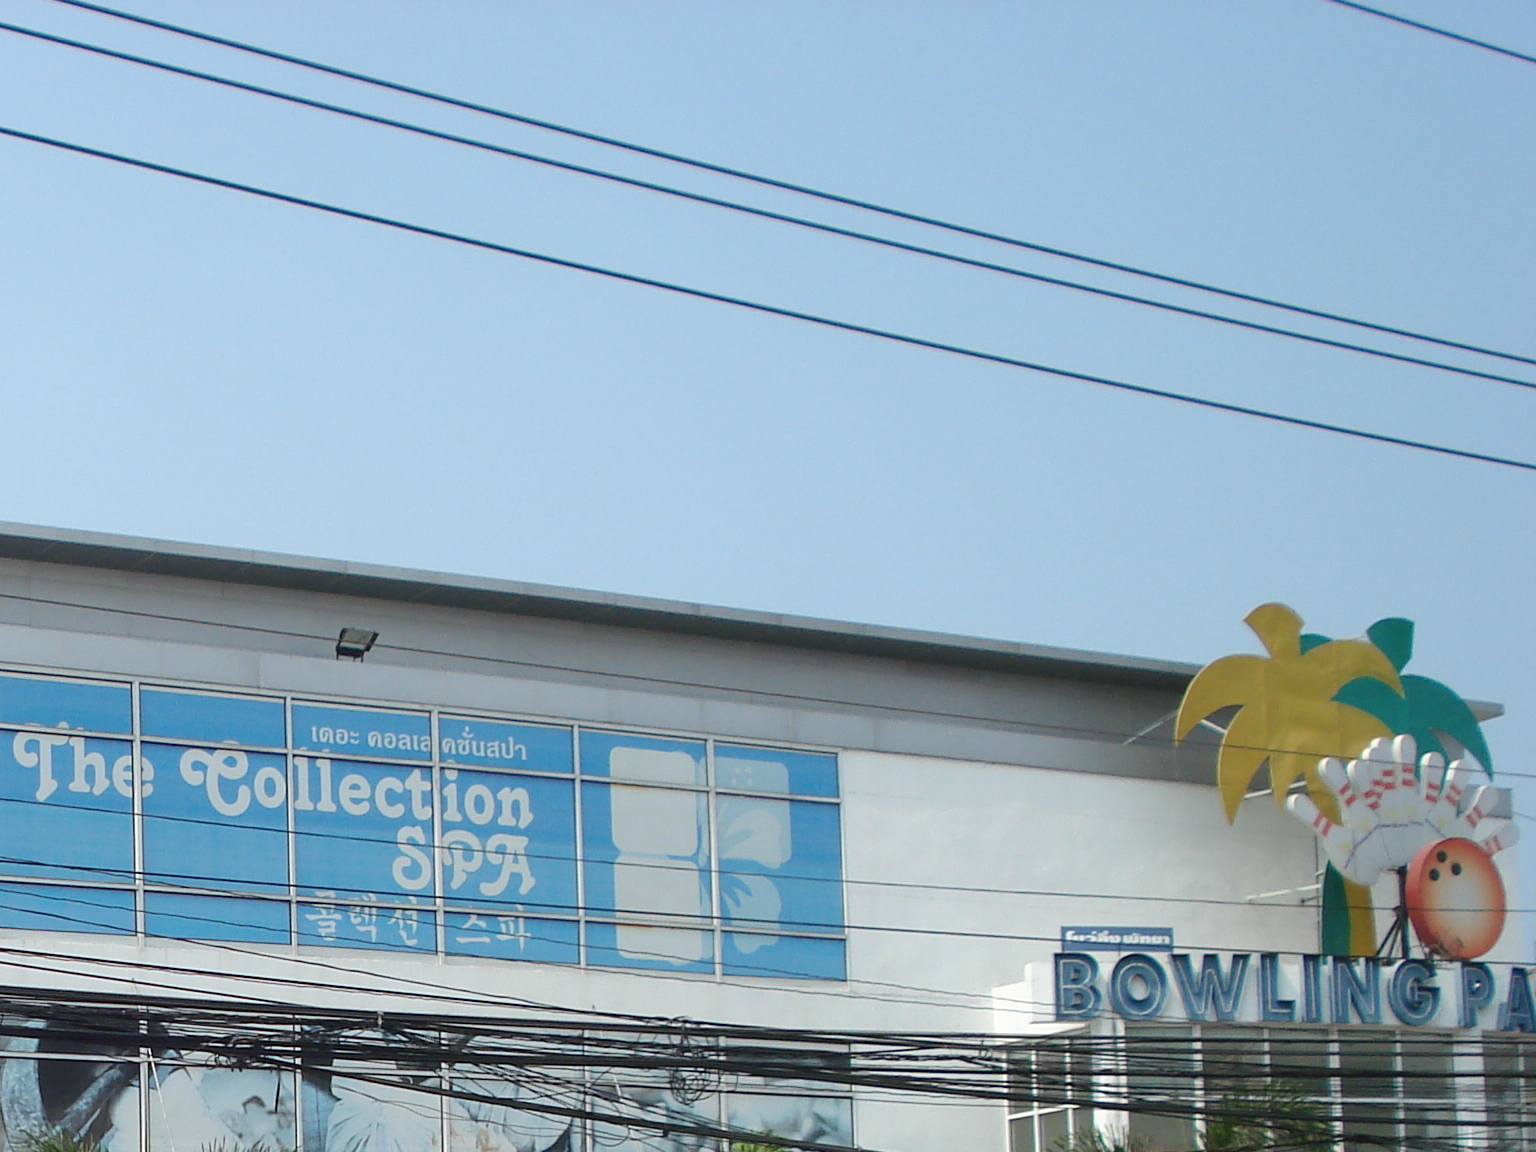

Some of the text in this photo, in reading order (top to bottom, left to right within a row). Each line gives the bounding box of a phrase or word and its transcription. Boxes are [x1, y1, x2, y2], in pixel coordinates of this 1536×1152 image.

[311, 726, 360, 746] เดอะ
[13, 721, 535, 829] The Collection
[392, 825, 536, 896] SPA
[1054, 952, 1441, 1026] BOWLING
